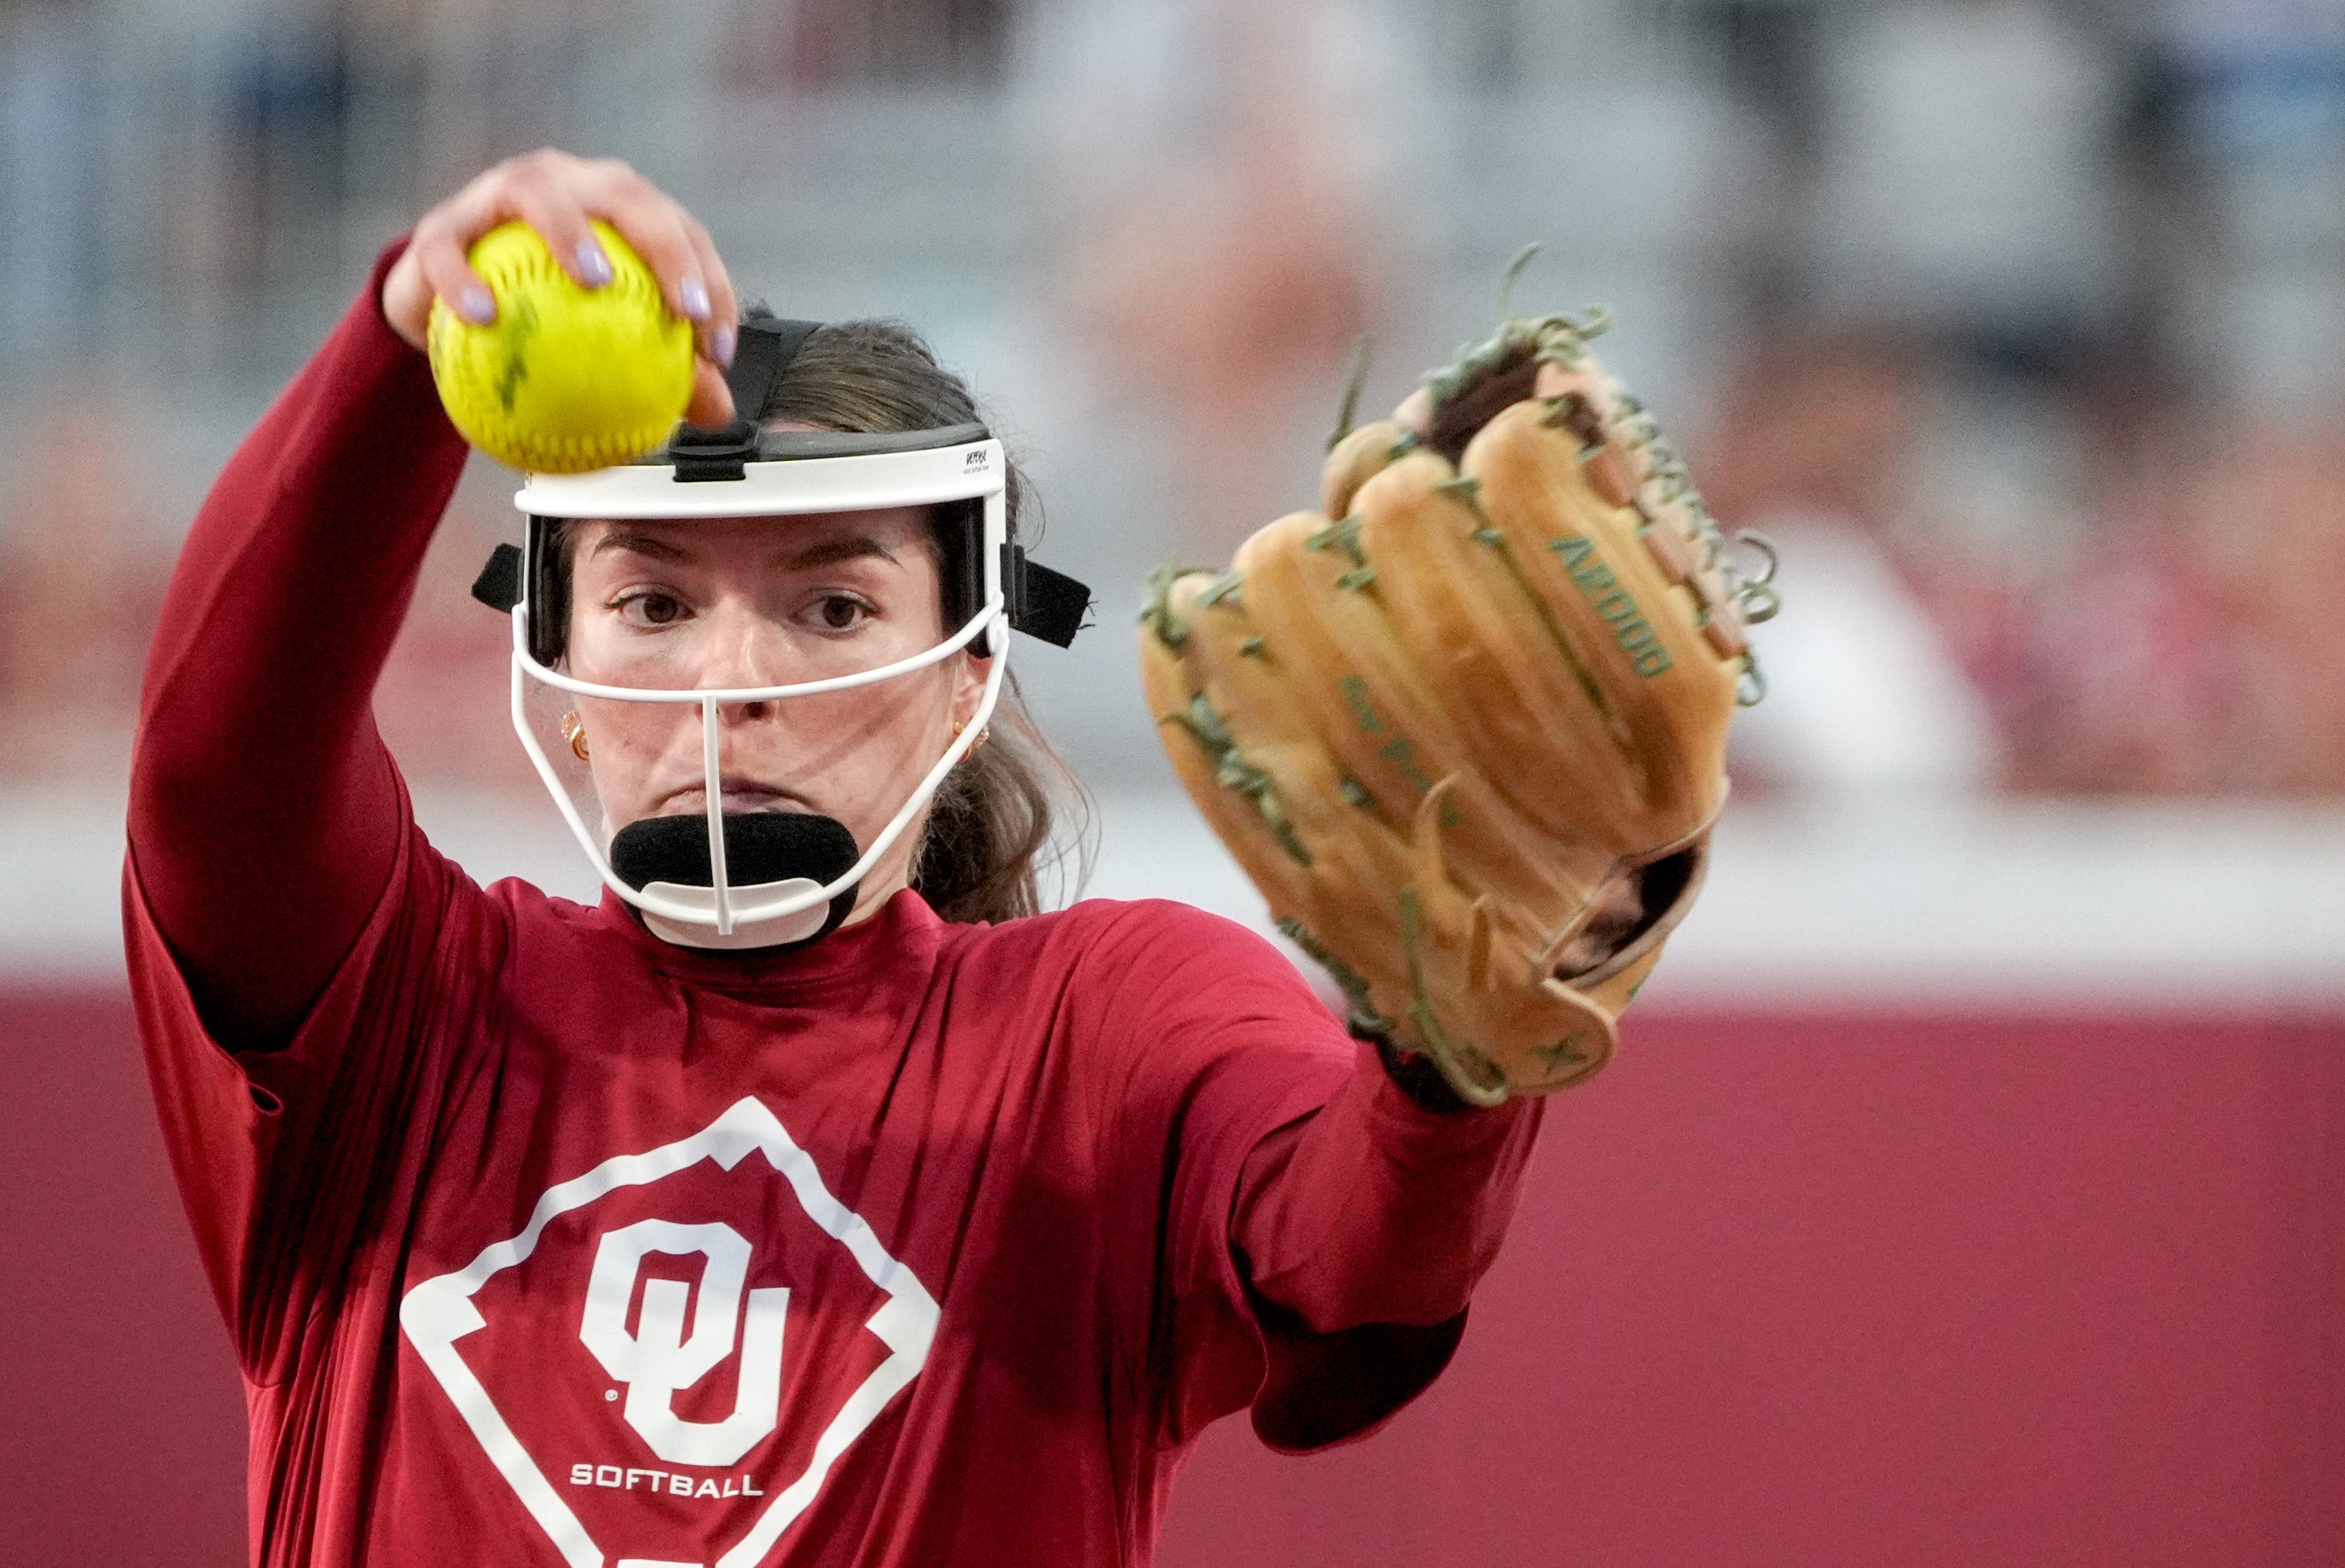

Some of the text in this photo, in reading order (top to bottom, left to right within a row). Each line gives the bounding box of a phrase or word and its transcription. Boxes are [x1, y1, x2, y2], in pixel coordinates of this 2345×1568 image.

[1545, 536, 1672, 678] A2000
[579, 1218, 792, 1467] OU
[570, 1463, 764, 1498] SOFTBALL
